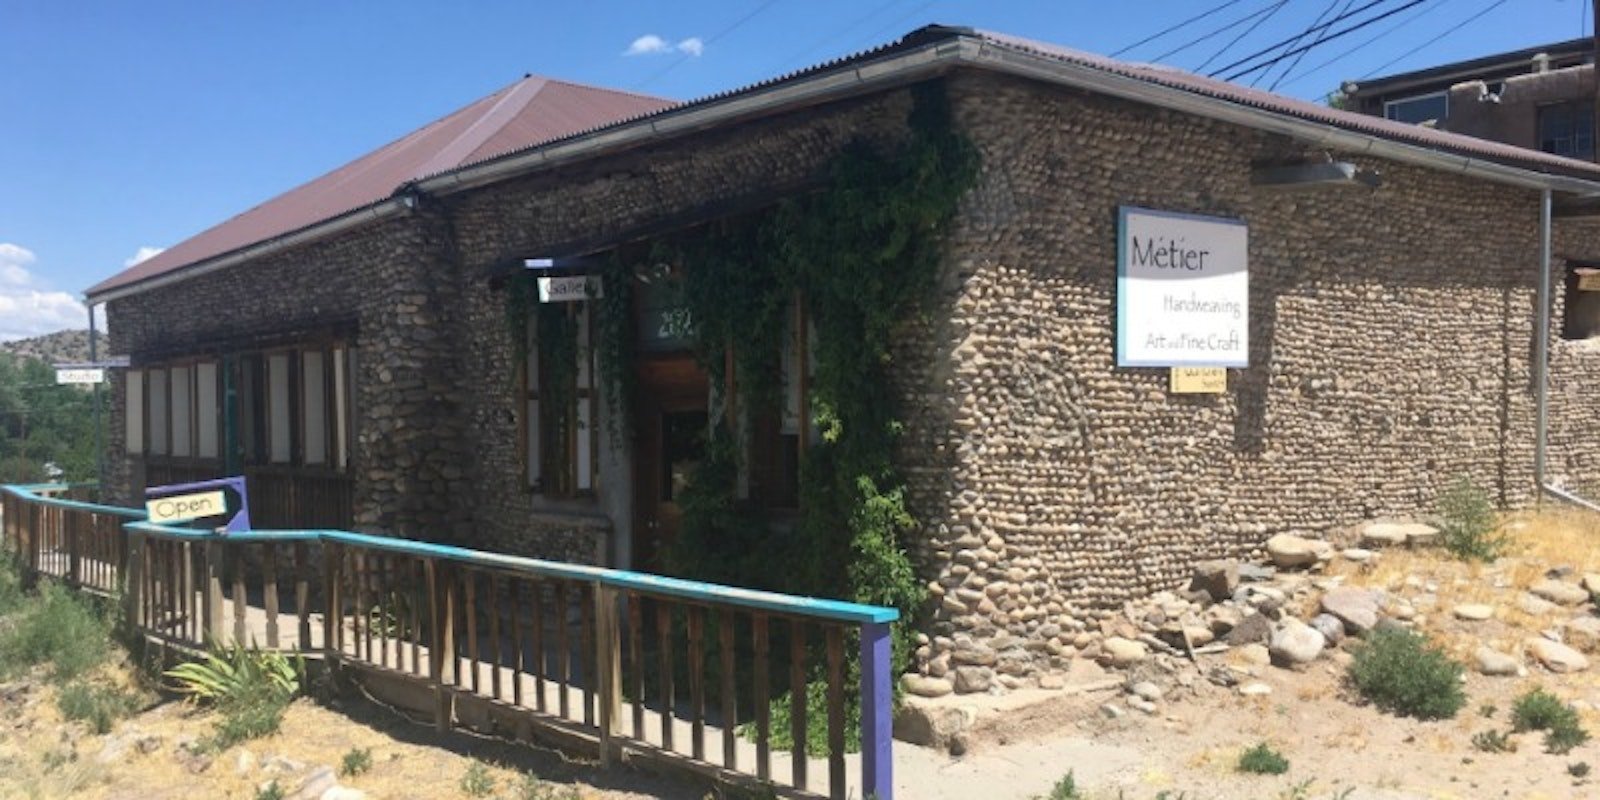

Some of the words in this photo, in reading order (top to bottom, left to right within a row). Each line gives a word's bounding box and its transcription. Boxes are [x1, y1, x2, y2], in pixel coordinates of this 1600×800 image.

[1131, 234, 1210, 271] Métier
[546, 279, 601, 297] Galle
[1163, 291, 1241, 319] Handweaving
[1144, 332, 1167, 349] Art
[1179, 333, 1207, 351] Fine
[1207, 329, 1240, 352] Craft
[156, 497, 213, 519] Open
